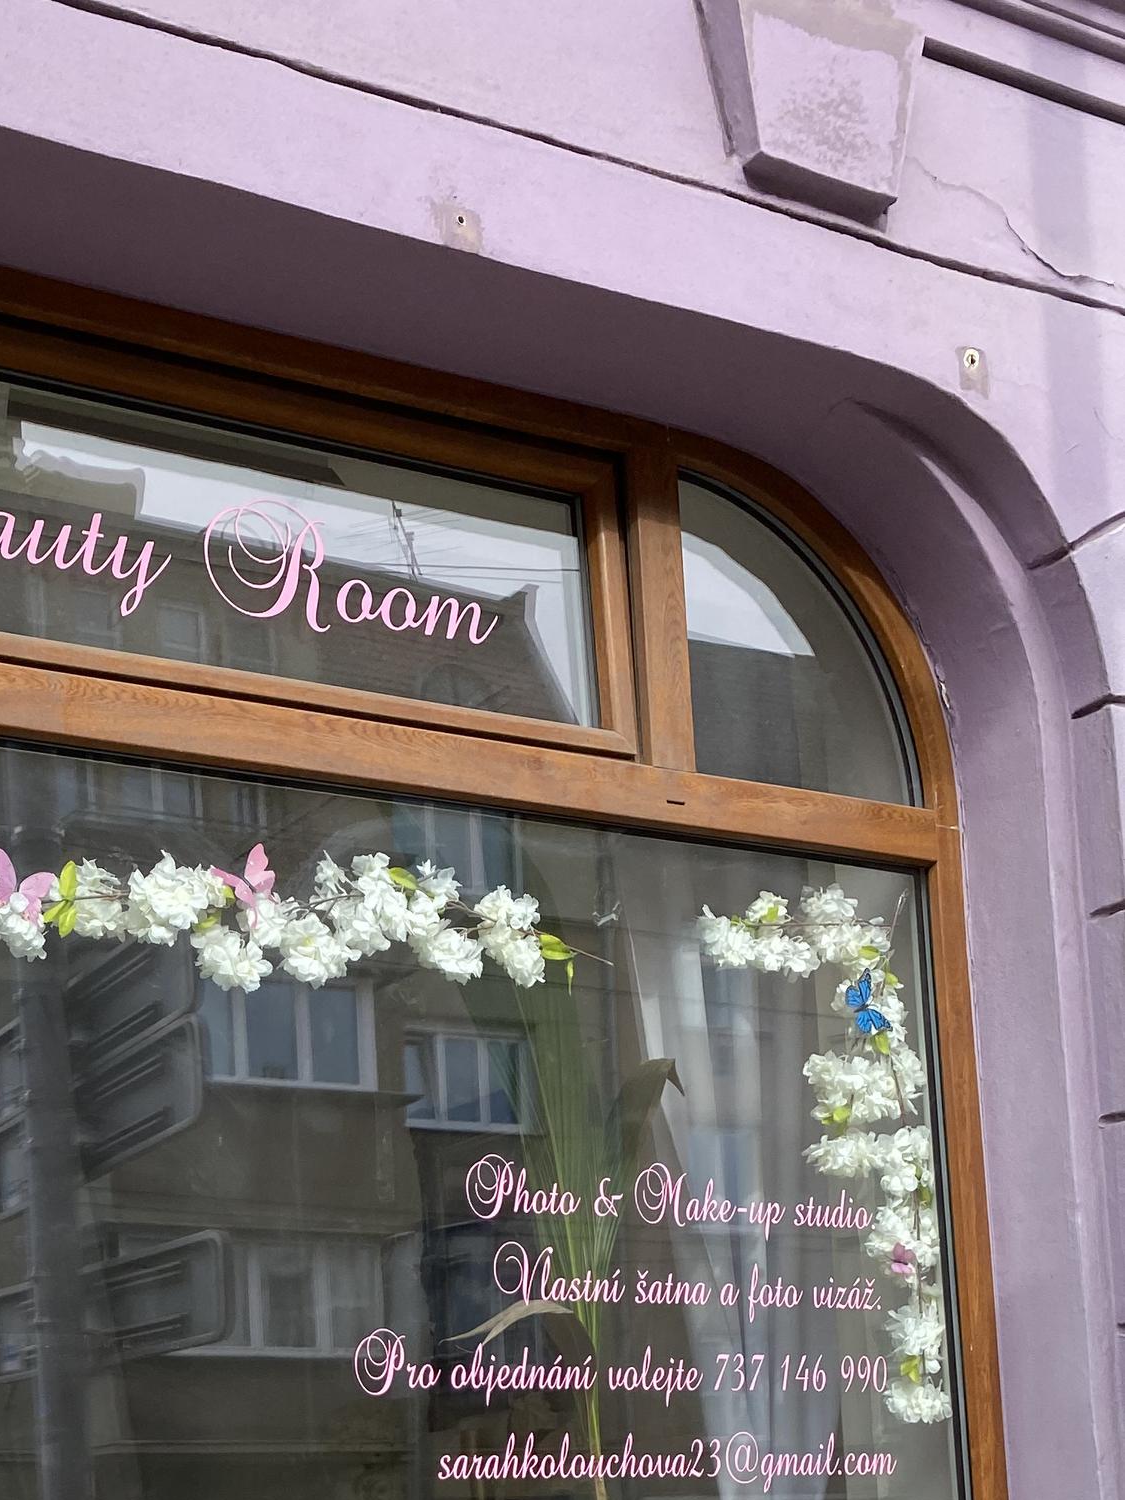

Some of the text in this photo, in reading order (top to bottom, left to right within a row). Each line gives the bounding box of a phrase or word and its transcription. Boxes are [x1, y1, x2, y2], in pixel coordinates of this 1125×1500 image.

[203, 498, 499, 646] Room
[465, 1153, 581, 1220] Photo
[593, 1176, 624, 1218] &
[634, 1162, 787, 1241] Make-up
[493, 1240, 882, 1324] Vlastní šatna a foto vizáž.
[354, 1328, 888, 1408] Pro objednání volejte 737 146 990
[437, 1431, 897, 1493] sarahkolouchova23@gmail.com
